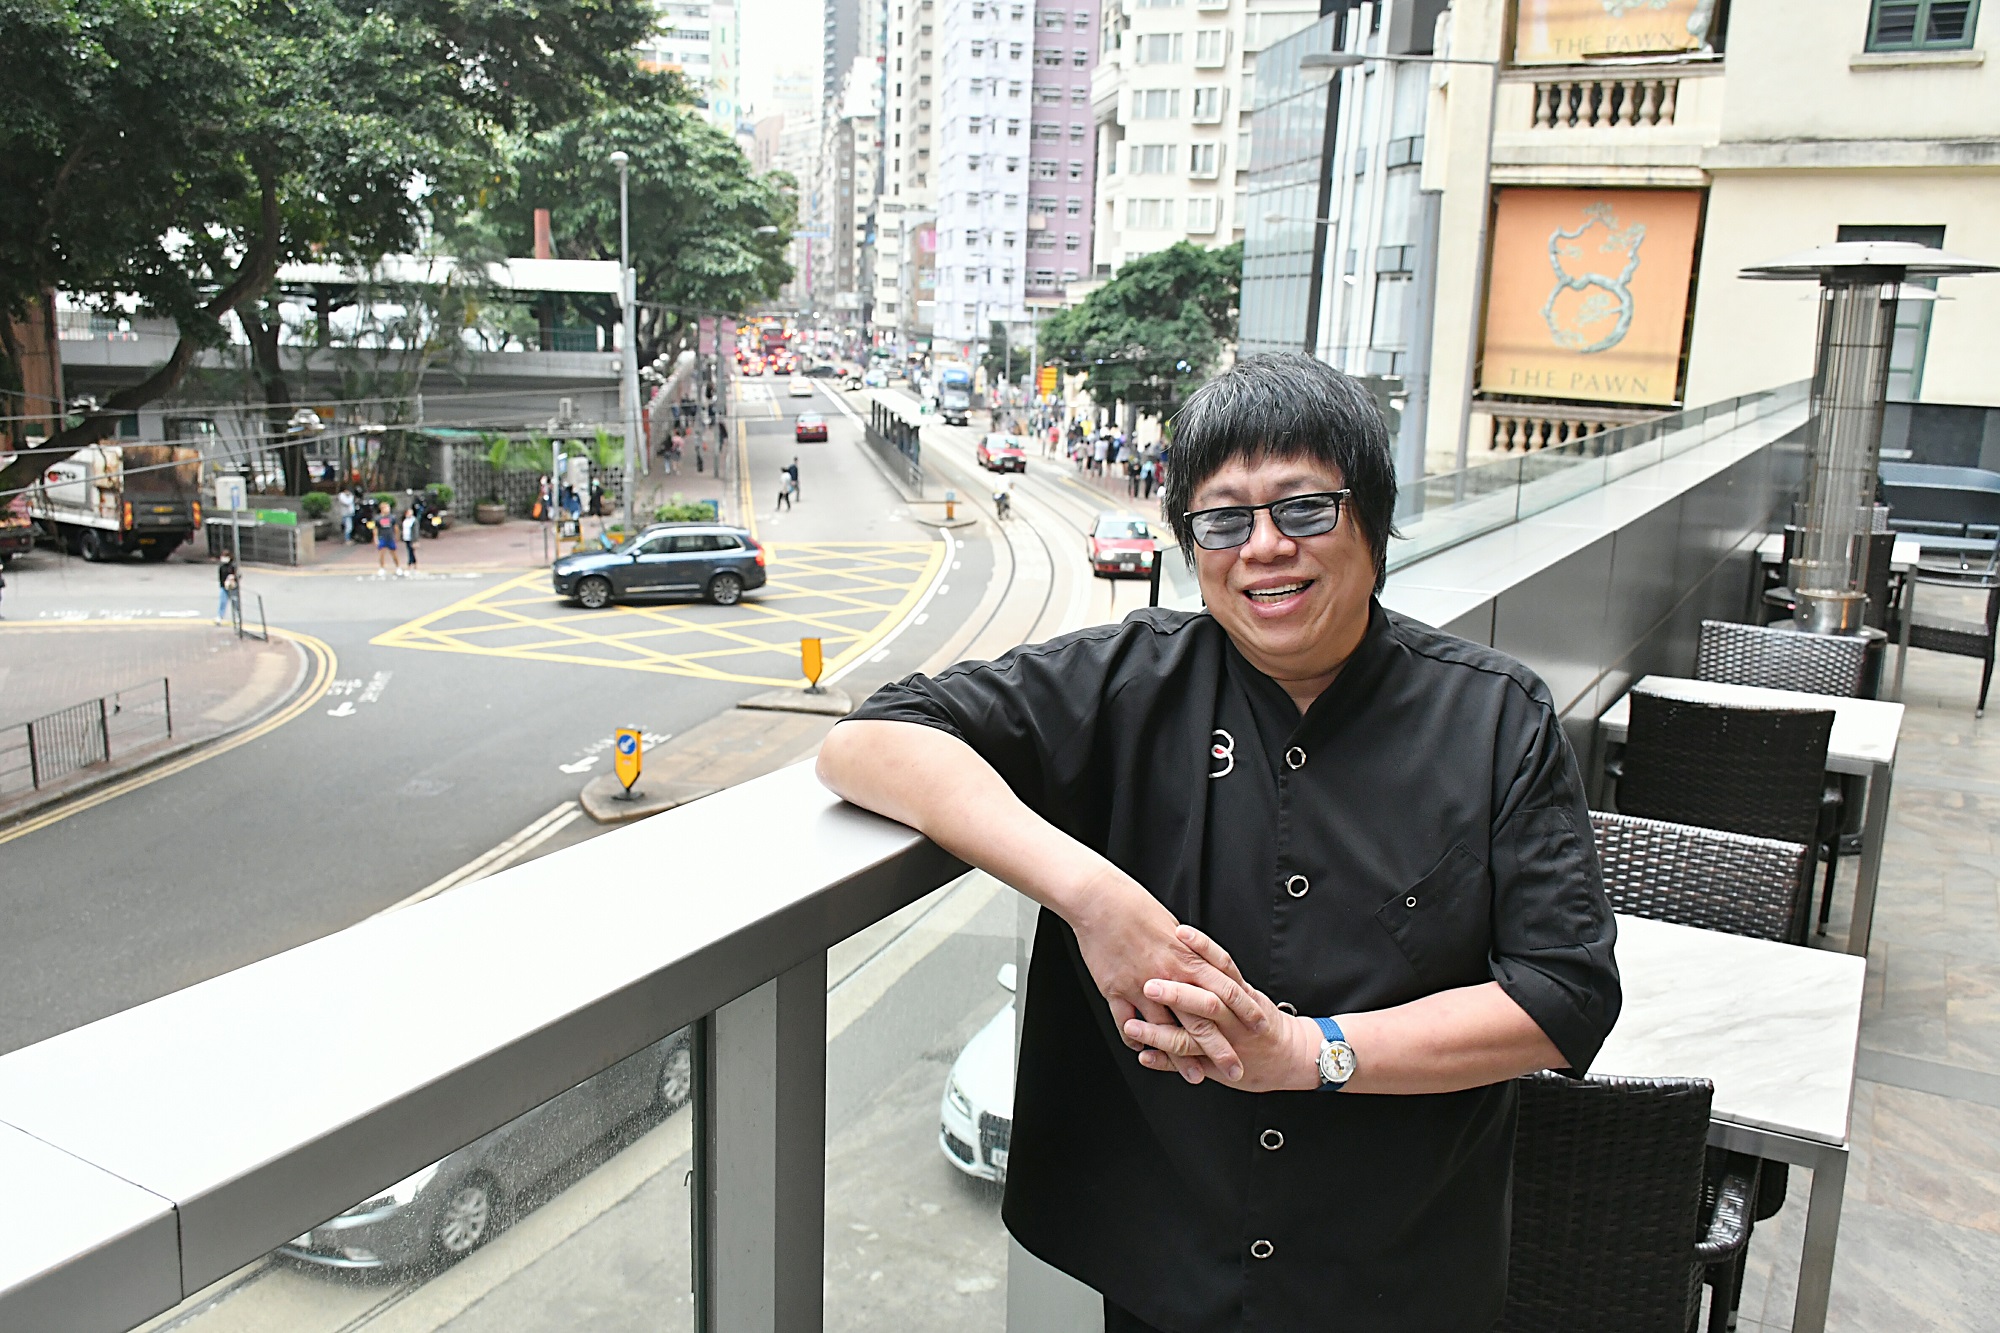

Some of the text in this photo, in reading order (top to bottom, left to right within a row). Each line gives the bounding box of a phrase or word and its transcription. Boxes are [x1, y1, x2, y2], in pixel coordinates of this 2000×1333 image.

[1555, 32, 1674, 54] THE PAWN
[1510, 368, 1648, 393] THE PAWN
